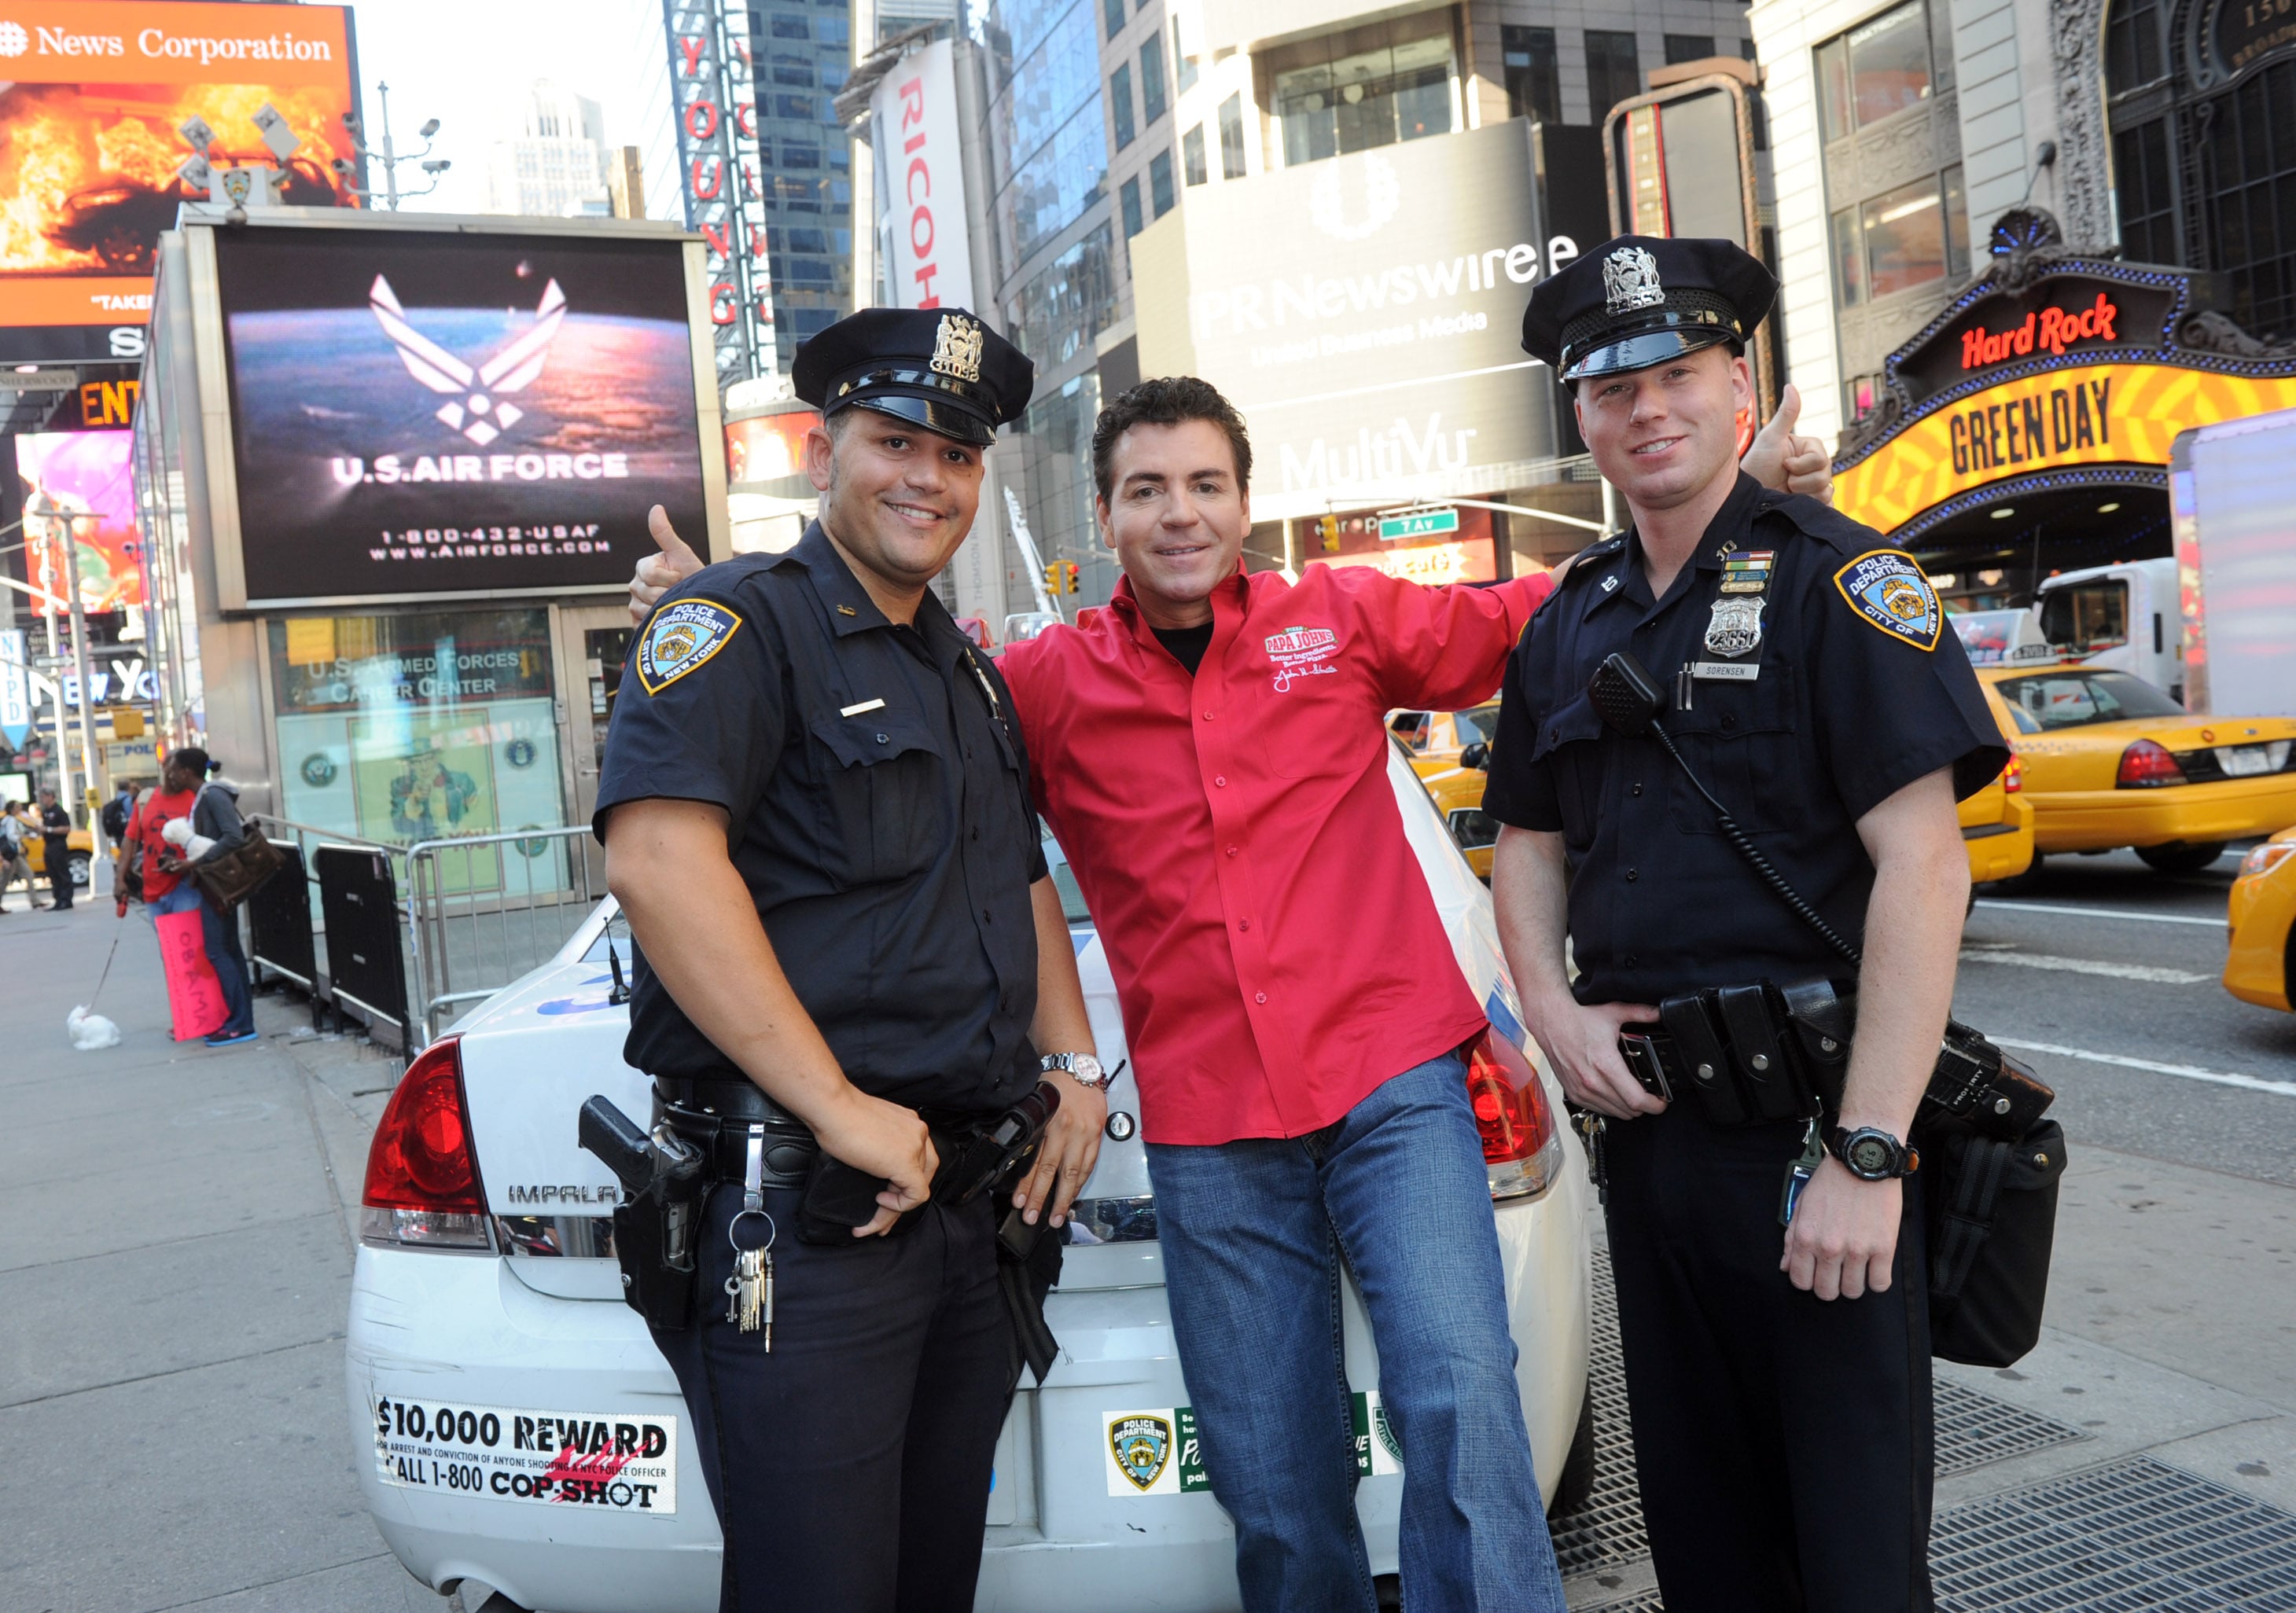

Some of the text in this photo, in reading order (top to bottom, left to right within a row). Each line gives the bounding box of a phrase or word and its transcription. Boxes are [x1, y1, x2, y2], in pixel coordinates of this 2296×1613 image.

[35, 26, 332, 65] News Corporation
[899, 75, 940, 309] RICOH
[1418, 311, 1488, 340] Media
[1961, 292, 2117, 369] Hard Rock
[1950, 377, 2110, 475] GREEN DAY
[489, 453, 629, 481] FORCE
[381, 524, 600, 545] 1-800-432-USAF
[1400, 521, 1411, 533] 7
[970, 543, 984, 601] THOMSON
[1856, 555, 1900, 574] POLICE
[1601, 575, 1618, 592] 10
[1849, 564, 1919, 596] DEPARTMENT
[653, 613, 726, 634] DEPARTMENT
[672, 604, 716, 618] POLICE
[1864, 605, 1914, 634] CITY OF
[1922, 582, 1937, 636] NEW YORK
[1267, 634, 1296, 651] PAPA
[307, 656, 359, 679] U.S.
[442, 652, 519, 671] FORCES
[642, 640, 652, 675] CITY OF
[664, 638, 720, 680] NEW YORK
[1705, 666, 1746, 676] SORENSEN
[418, 678, 495, 698] CENTER
[509, 1184, 618, 1203] IMPALA
[377, 1396, 667, 1460] $10,000 REWARD
[1113, 1427, 1167, 1443] DEPARTMENT
[1123, 1419, 1155, 1430] POLICE
[390, 1442, 416, 1453] ARREST
[418, 1446, 433, 1457] AND
[434, 1448, 480, 1463] CONVICTION
[481, 1455, 491, 1464] OF
[493, 1455, 526, 1468] ANYONE
[528, 1459, 570, 1473] SHOOTING
[572, 1463, 579, 1473] A
[580, 1462, 598, 1475] NYC
[600, 1464, 628, 1477] POLICE
[631, 1466, 667, 1479] OFFICER
[1116, 1448, 1138, 1479] CITY OF
[1146, 1443, 1168, 1482] NEW YORK
[432, 1461, 483, 1492] 1-800
